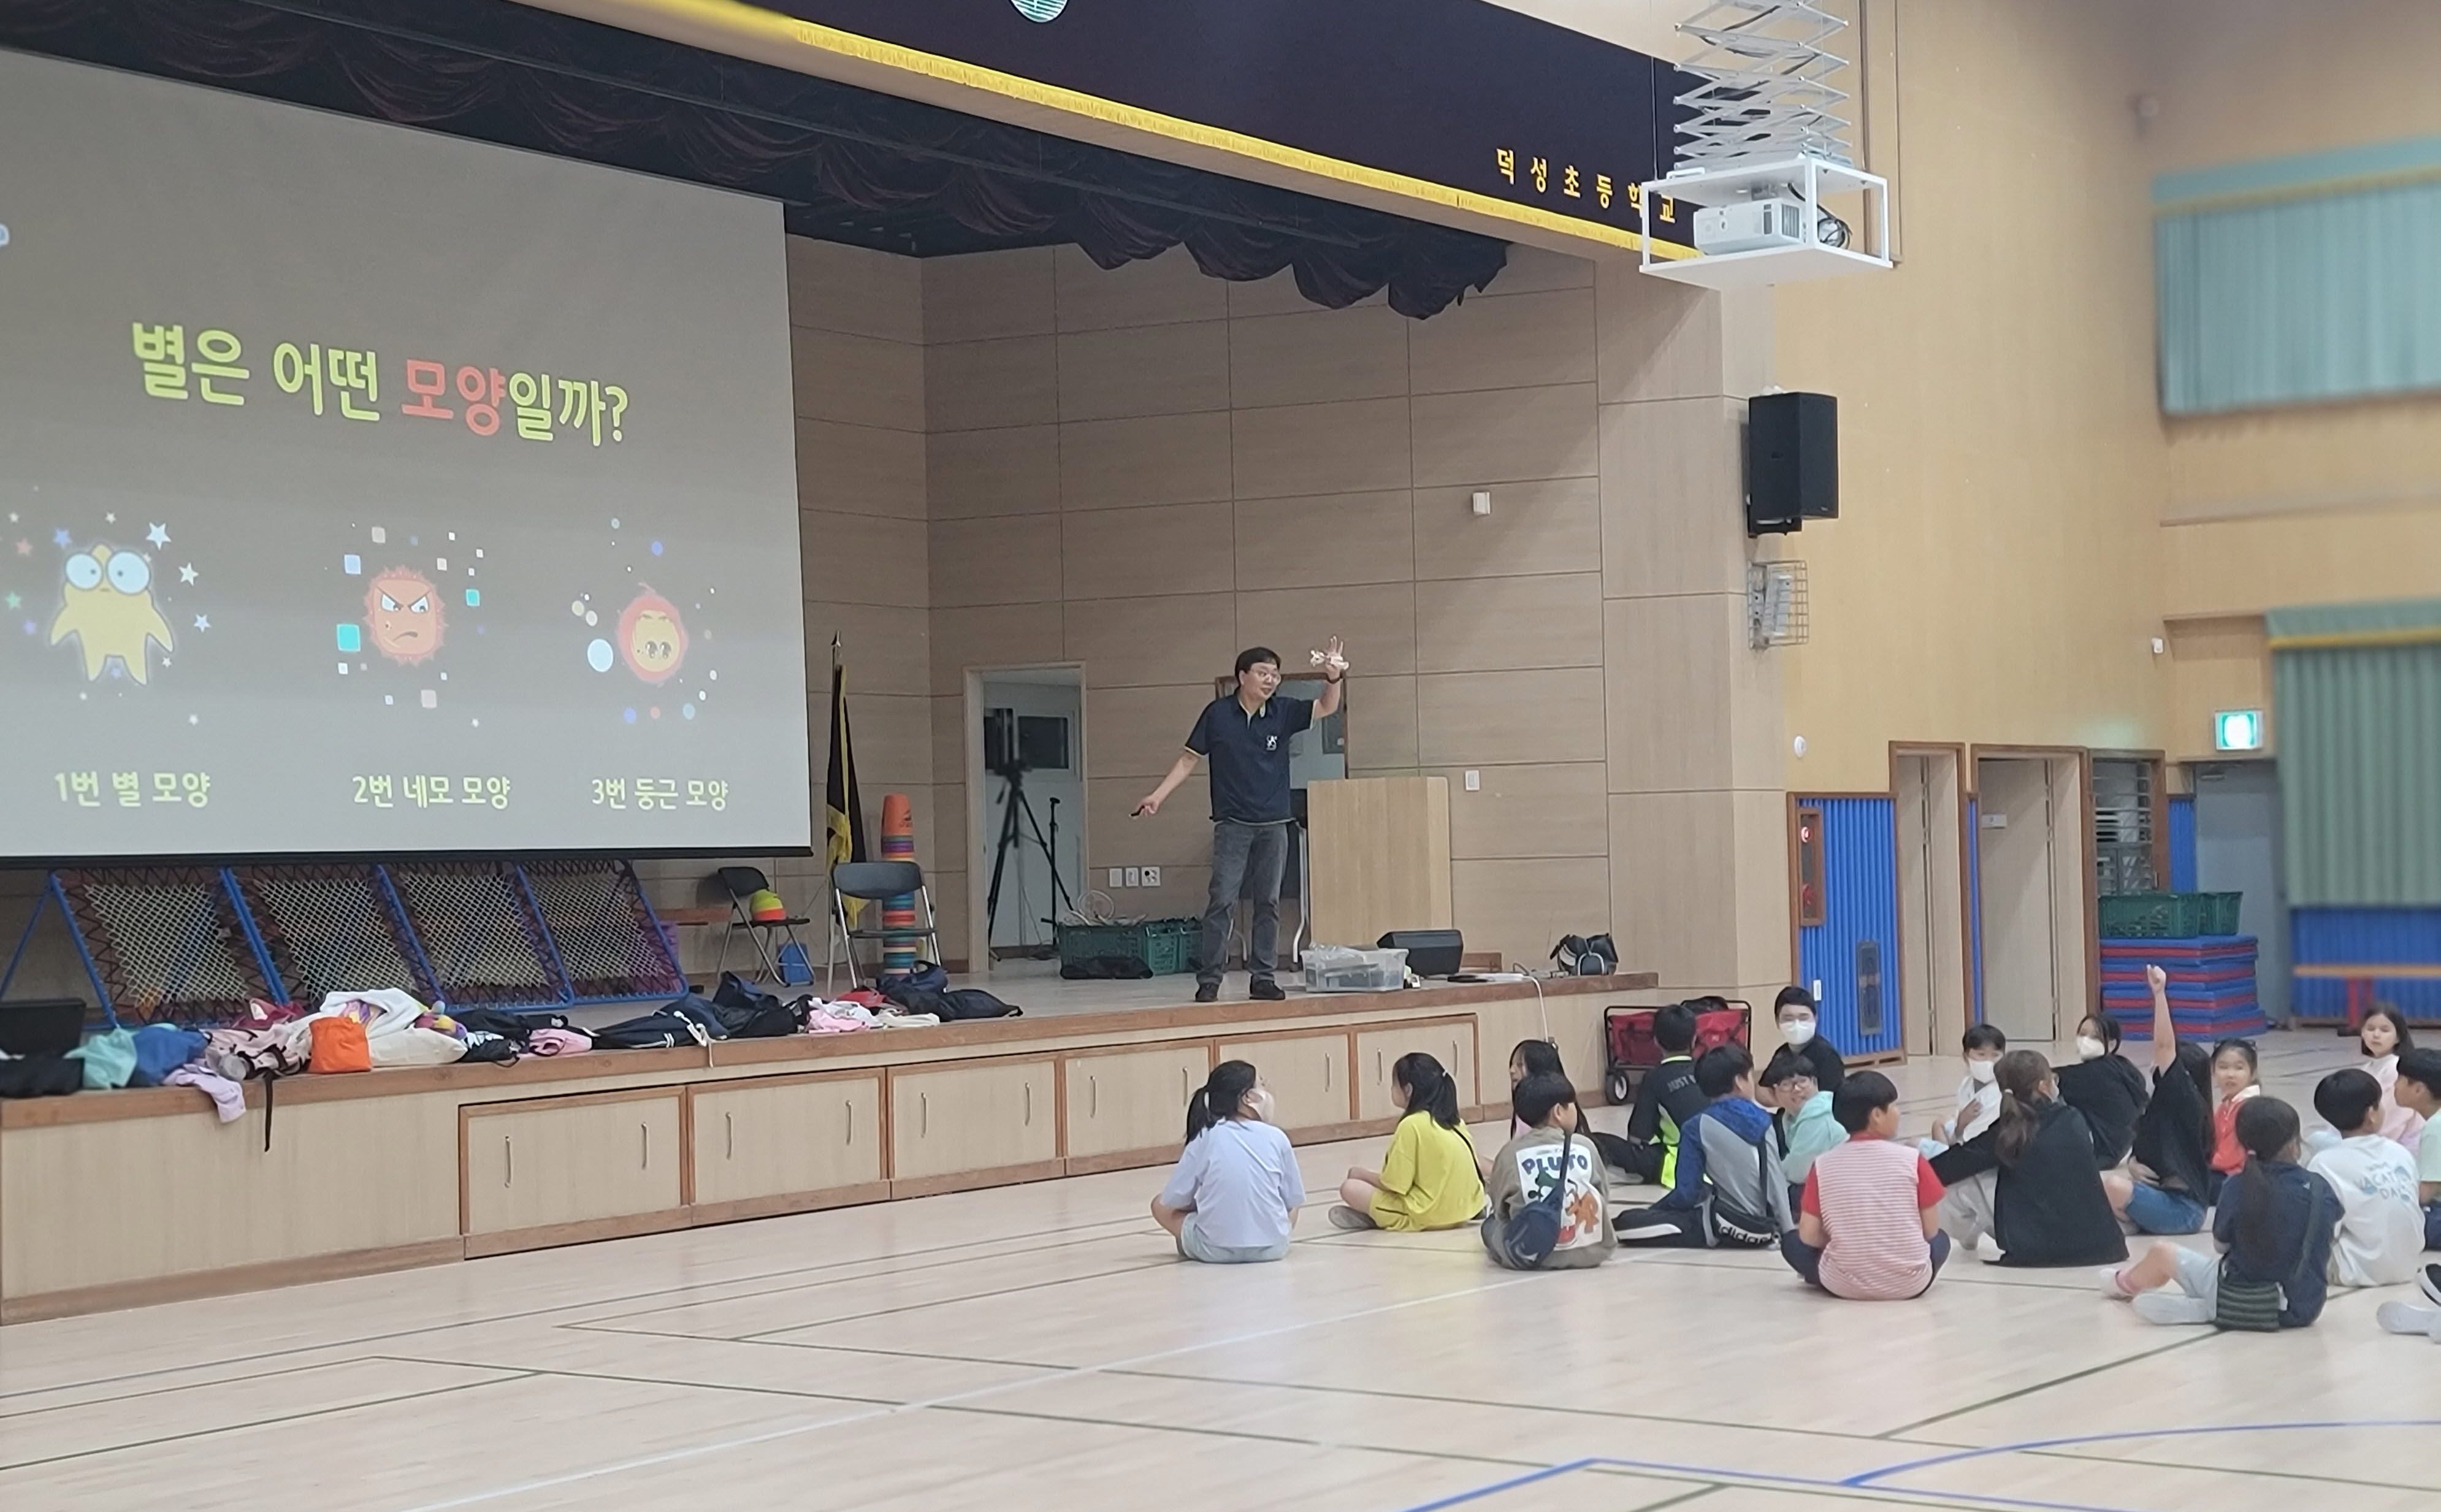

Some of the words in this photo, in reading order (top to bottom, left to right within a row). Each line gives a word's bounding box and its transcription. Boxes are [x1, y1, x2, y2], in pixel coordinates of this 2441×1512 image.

[132, 322, 250, 406] 별은
[273, 342, 380, 422] 어떤
[401, 359, 628, 447] 모양일까?
[55, 771, 101, 807] 1번
[112, 771, 142, 808] 별
[152, 771, 211, 808] 모양
[352, 774, 394, 808] 2번
[402, 774, 454, 809] 네모
[461, 776, 511, 810] 모양
[591, 777, 627, 809] 3번
[633, 778, 679, 811] 둥근
[686, 779, 729, 812] 모양
[1521, 1154, 1588, 1175] PLUTO
